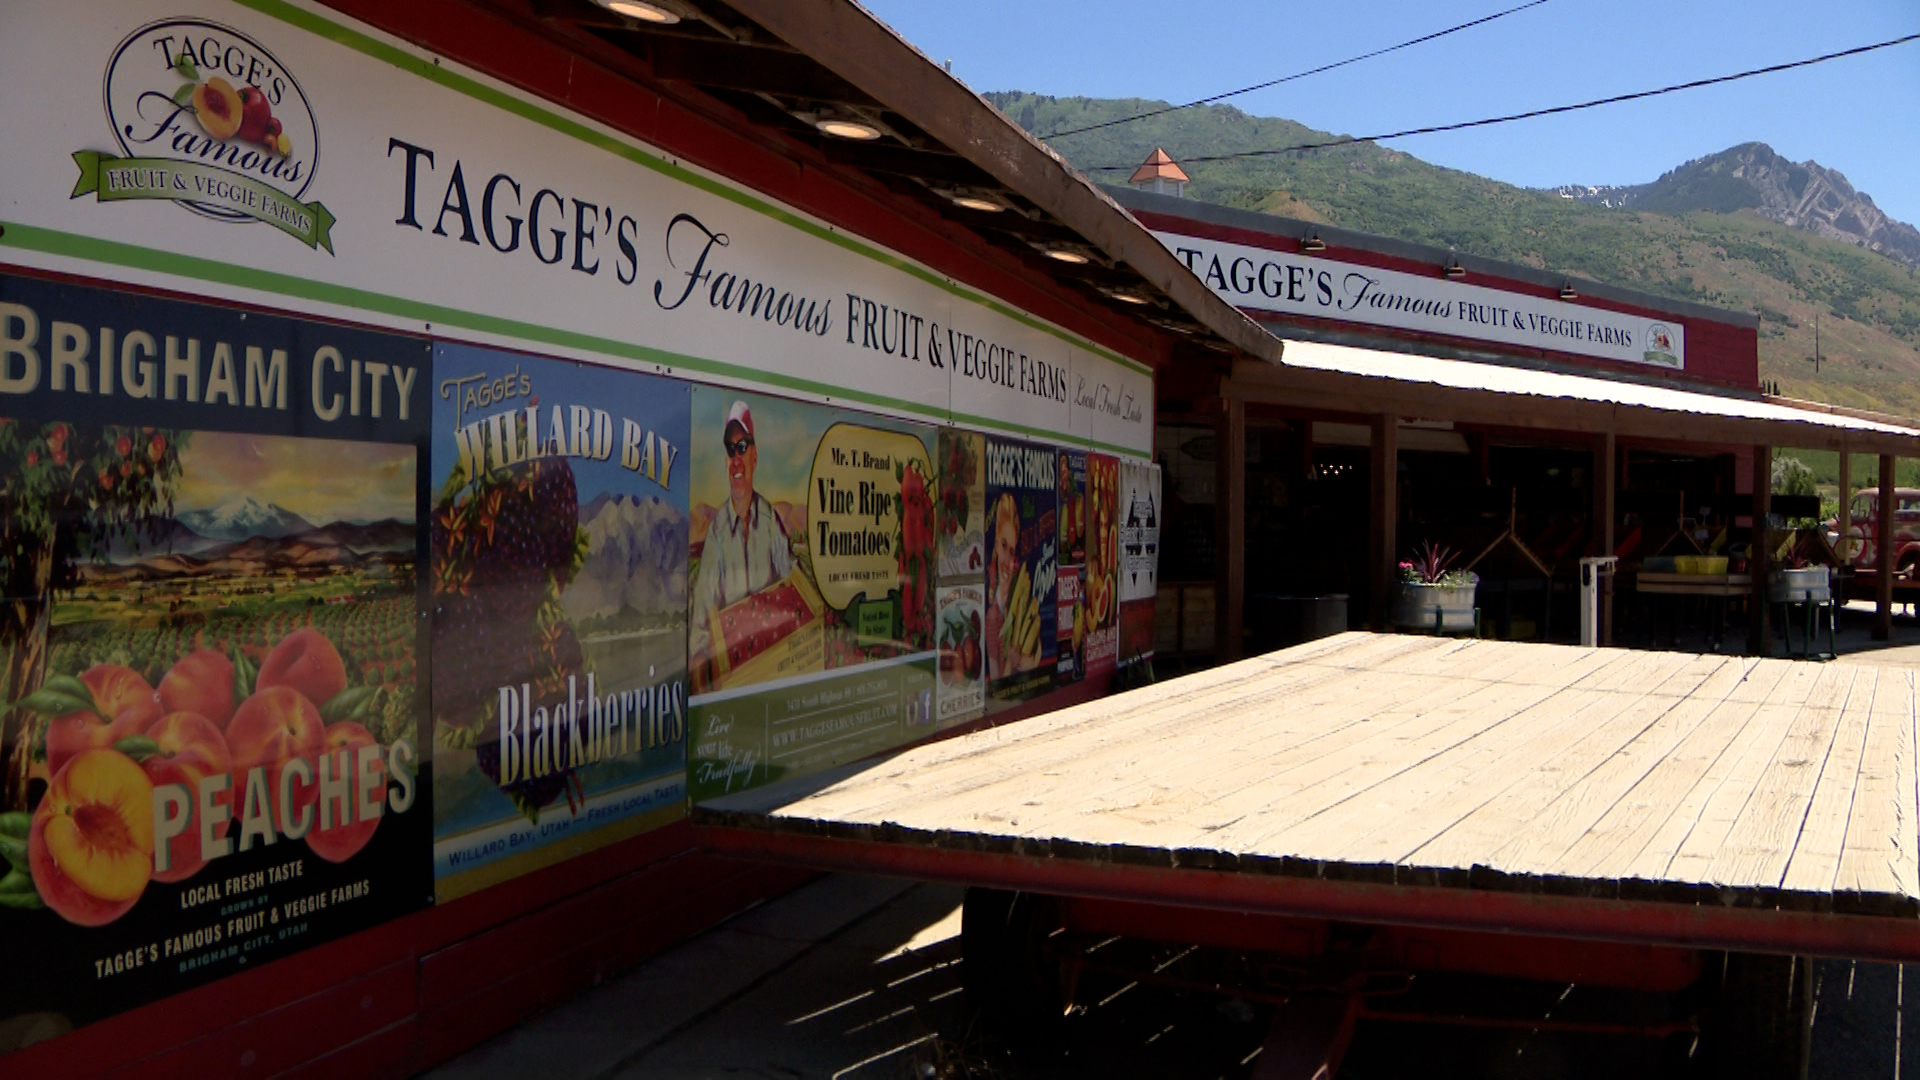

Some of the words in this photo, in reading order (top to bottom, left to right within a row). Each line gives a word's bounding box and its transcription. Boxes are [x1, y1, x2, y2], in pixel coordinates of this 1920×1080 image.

[153, 36, 286, 105] TAGGE'S
[125, 91, 304, 182] Famous
[108, 170, 168, 189] FRUIT
[173, 174, 188, 190] &
[195, 175, 257, 209] VEGGIE
[261, 198, 312, 234] FARMS
[388, 137, 638, 285] TAGGE'S
[654, 213, 833, 336] Famous
[846, 293, 924, 361] FRUIT
[928, 323, 944, 368] &
[948, 329, 1015, 388] VEGGIE
[1019, 354, 1066, 403] FARMS
[1176, 247, 1332, 306] TAGGE'S
[1337, 273, 1453, 319] Famous
[1459, 301, 1508, 328] FRUIT
[1513, 311, 1526, 331] &
[1528, 314, 1583, 340] VEGGIE
[1587, 323, 1632, 348] FARMS
[0, 303, 289, 410] BRIGHAM
[311, 345, 418, 421] CITY
[440, 363, 532, 433] TAGGE'S
[454, 405, 614, 485] WILLARD
[620, 417, 678, 491] BAY
[831, 447, 849, 466] Mr.
[851, 449, 861, 467] T.
[863, 451, 891, 471] Brand
[817, 477, 854, 515] Vine
[858, 481, 892, 526] Ripe
[817, 521, 891, 557] Tomatoes
[499, 666, 684, 787] Blackberries
[153, 738, 417, 873] PEACHES
[449, 839, 505, 866] WILLARD
[541, 820, 569, 837] UTAH
[588, 805, 620, 822] FRESH
[623, 794, 650, 812] LOCAL
[654, 784, 680, 800] TASTE
[181, 883, 221, 910] LOCAL
[225, 871, 265, 897] FRESH
[268, 859, 304, 885] TASTE
[94, 943, 158, 979] TAGGE'S
[164, 924, 222, 957] FAMOUS
[227, 911, 265, 938] FRUIT
[270, 907, 279, 924] &
[284, 893, 328, 919] VEGGIE
[331, 879, 370, 906] FARMS
[179, 946, 239, 973] BRIGHAM
[279, 922, 308, 940] UTAH
